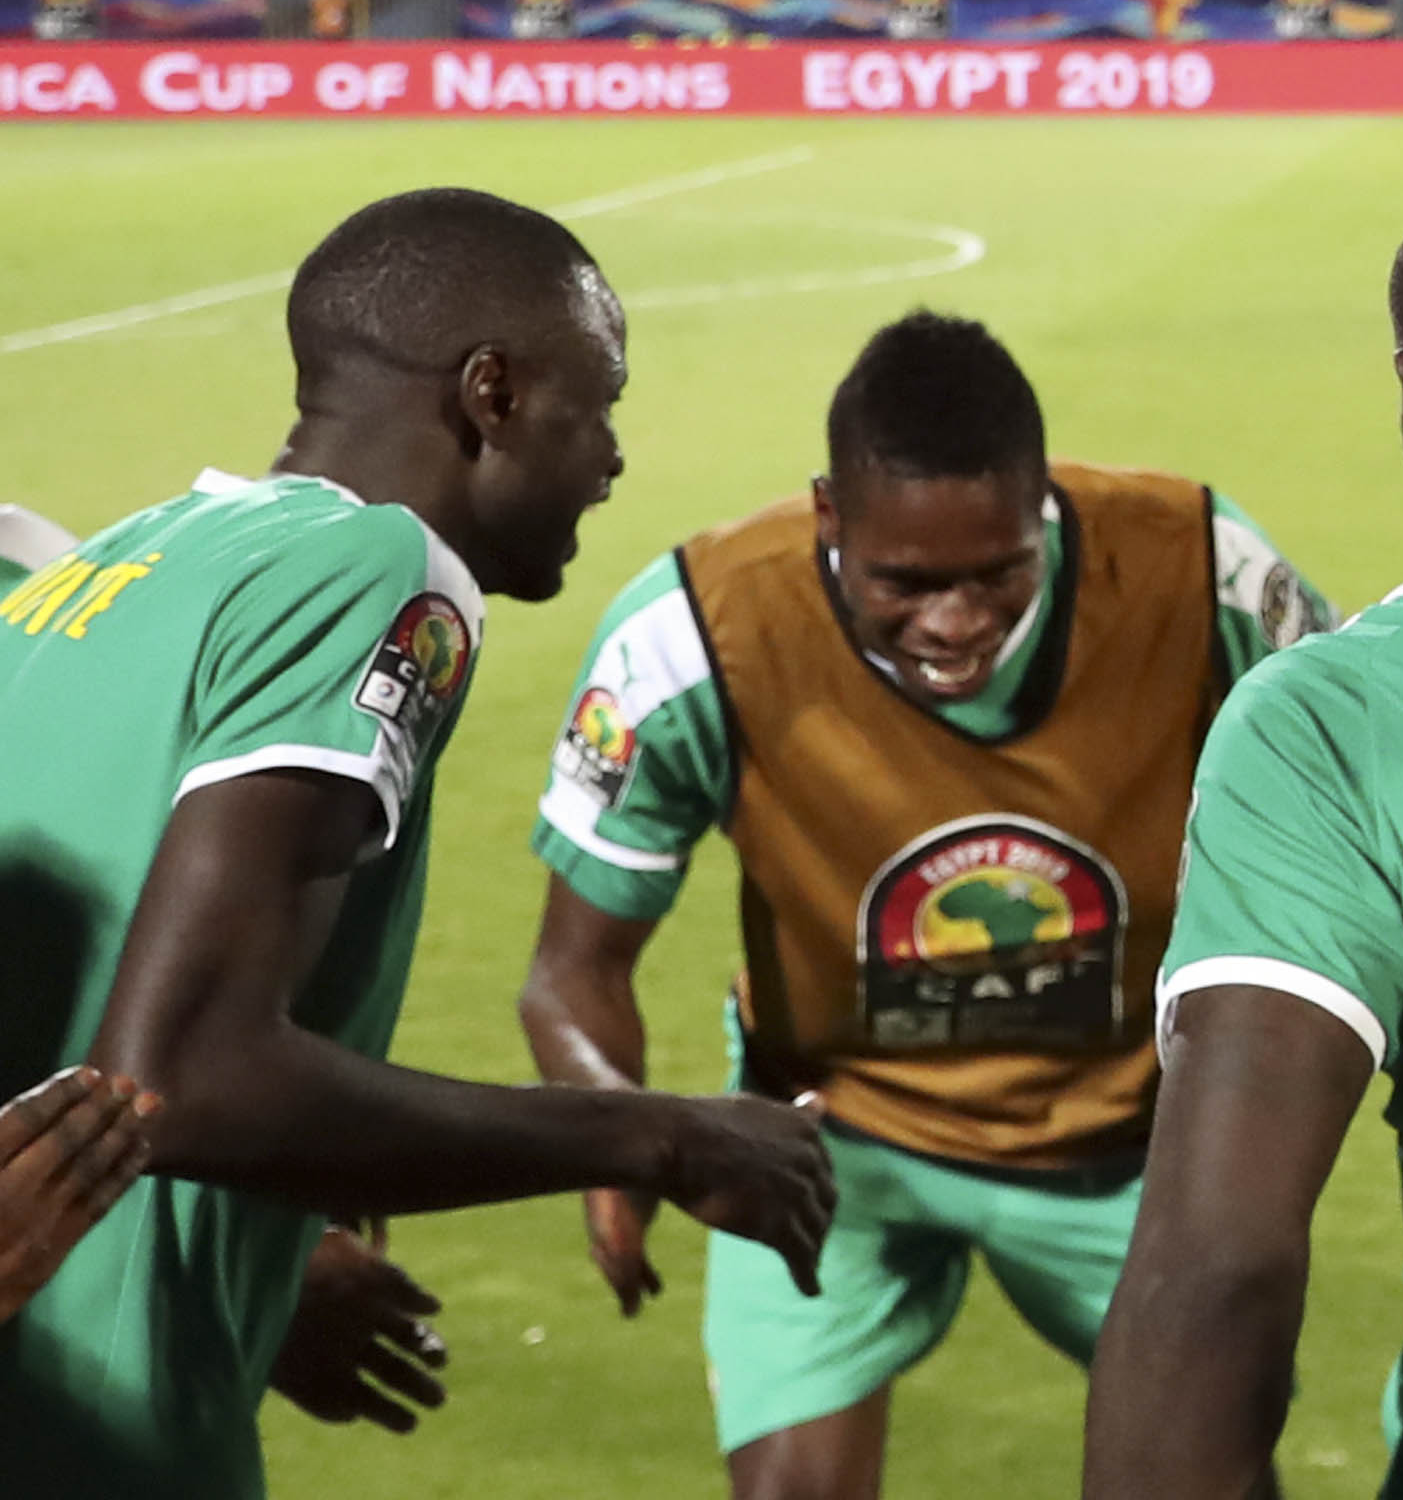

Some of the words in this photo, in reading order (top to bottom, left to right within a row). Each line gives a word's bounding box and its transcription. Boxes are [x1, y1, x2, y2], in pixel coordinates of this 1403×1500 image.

[140, 52, 292, 111] CUP
[315, 62, 407, 110] OF
[433, 53, 730, 110] NATIONS
[802, 51, 1040, 109] EGYPT
[1058, 52, 1214, 109] 2019
